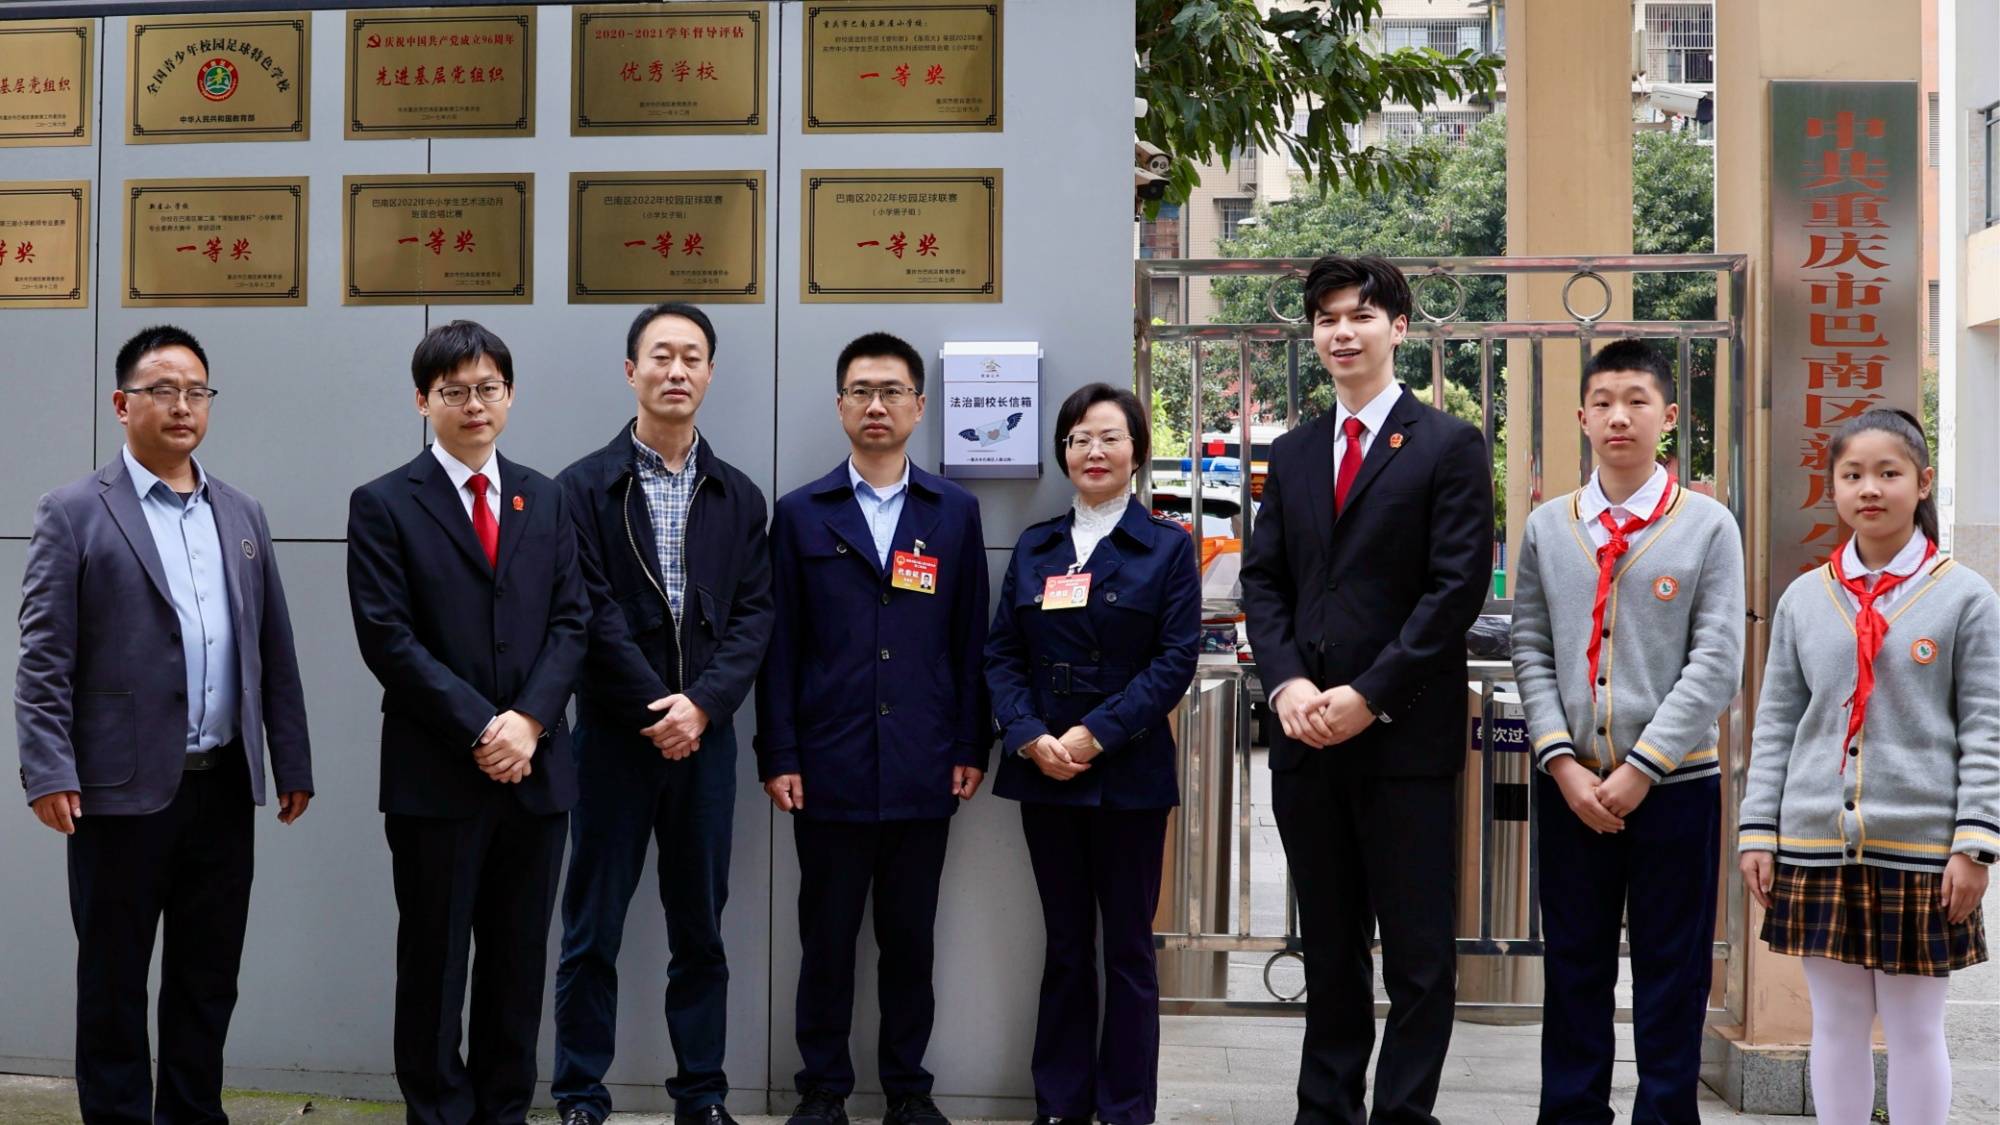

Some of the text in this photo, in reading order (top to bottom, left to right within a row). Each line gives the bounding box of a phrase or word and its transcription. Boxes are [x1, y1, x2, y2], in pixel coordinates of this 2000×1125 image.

[384, 34, 515, 48] 庆祝中国共产党成立96周年
[594, 26, 744, 40] 2020-2021学年督导评估
[147, 38, 291, 96] 全国青少年校园足球特色学校
[375, 64, 505, 86] 先进基层党组织
[620, 60, 720, 82] 优秀学校
[860, 63, 946, 88] 一等奖
[179, 114, 255, 123] 中华人民共和国教育部
[603, 195, 723, 207] 巴南区2022年校园足球联赛
[835, 193, 958, 204] 巴南区2022年校园足球联赛
[176, 236, 252, 264] 一等奖
[397, 227, 477, 256] 一等奖
[624, 228, 706, 259] 一等奖
[856, 231, 940, 259] 一等奖
[950, 397, 1032, 408] 法治副校长信箱
